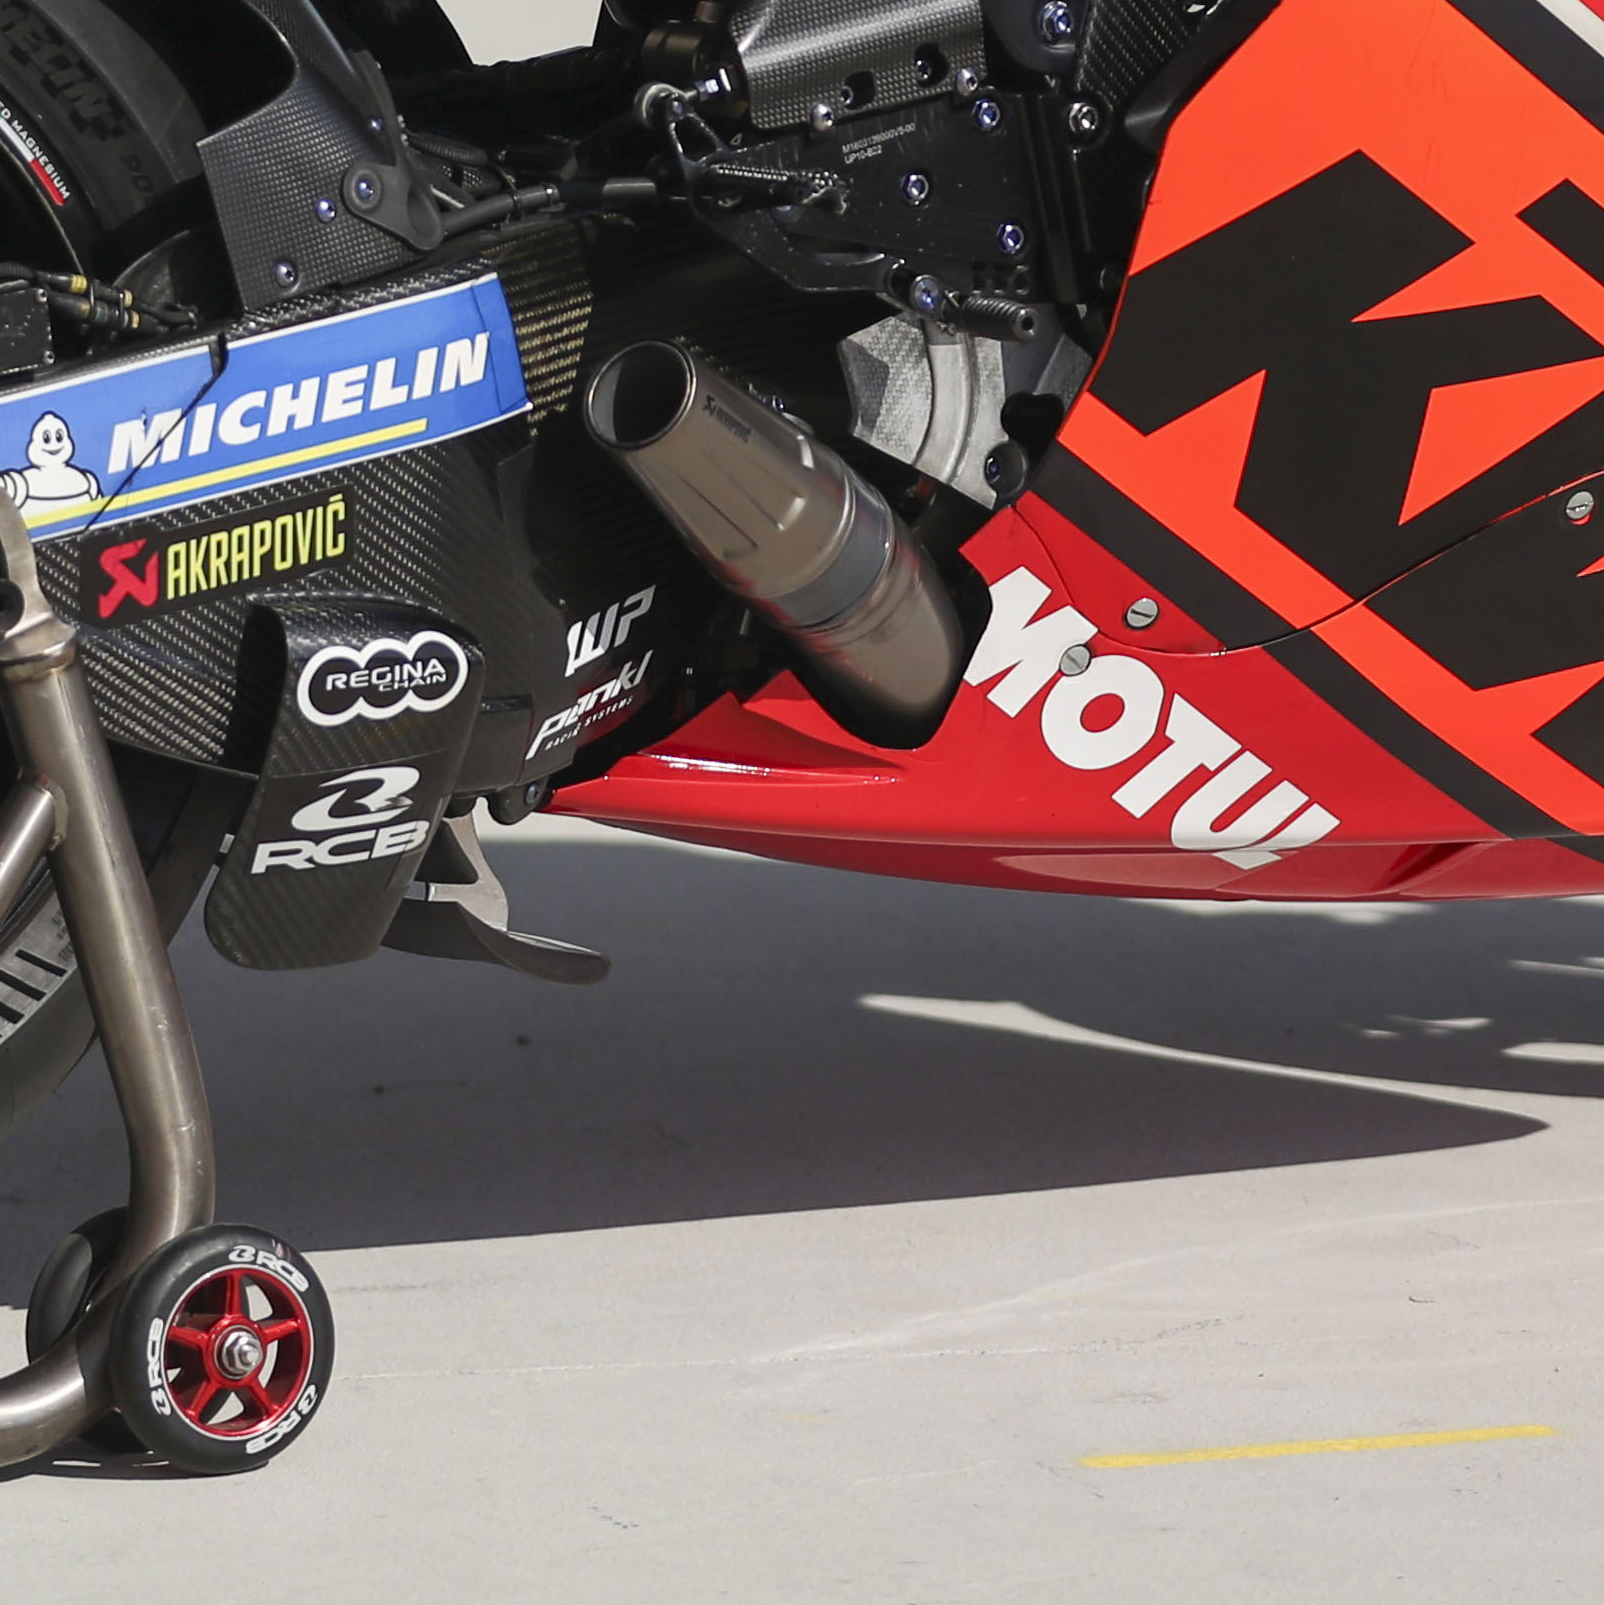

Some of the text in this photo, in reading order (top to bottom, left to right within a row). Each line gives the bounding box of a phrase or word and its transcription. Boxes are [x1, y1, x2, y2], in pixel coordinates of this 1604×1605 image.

[11, 120, 70, 199] MAGNESIUM
[107, 330, 490, 476] MICHELIN
[166, 494, 347, 601] AKRAPOVIČ
[564, 585, 657, 678] WP
[326, 658, 446, 692] REGINA
[379, 673, 447, 693] CHAIN
[584, 695, 634, 727] SYSTEMS
[963, 566, 1342, 871] MOTUL
[250, 821, 430, 876] RCB
[255, 1253, 310, 1292] RCB
[146, 1317, 165, 1388] RCB
[244, 1410, 302, 1454] RCB
